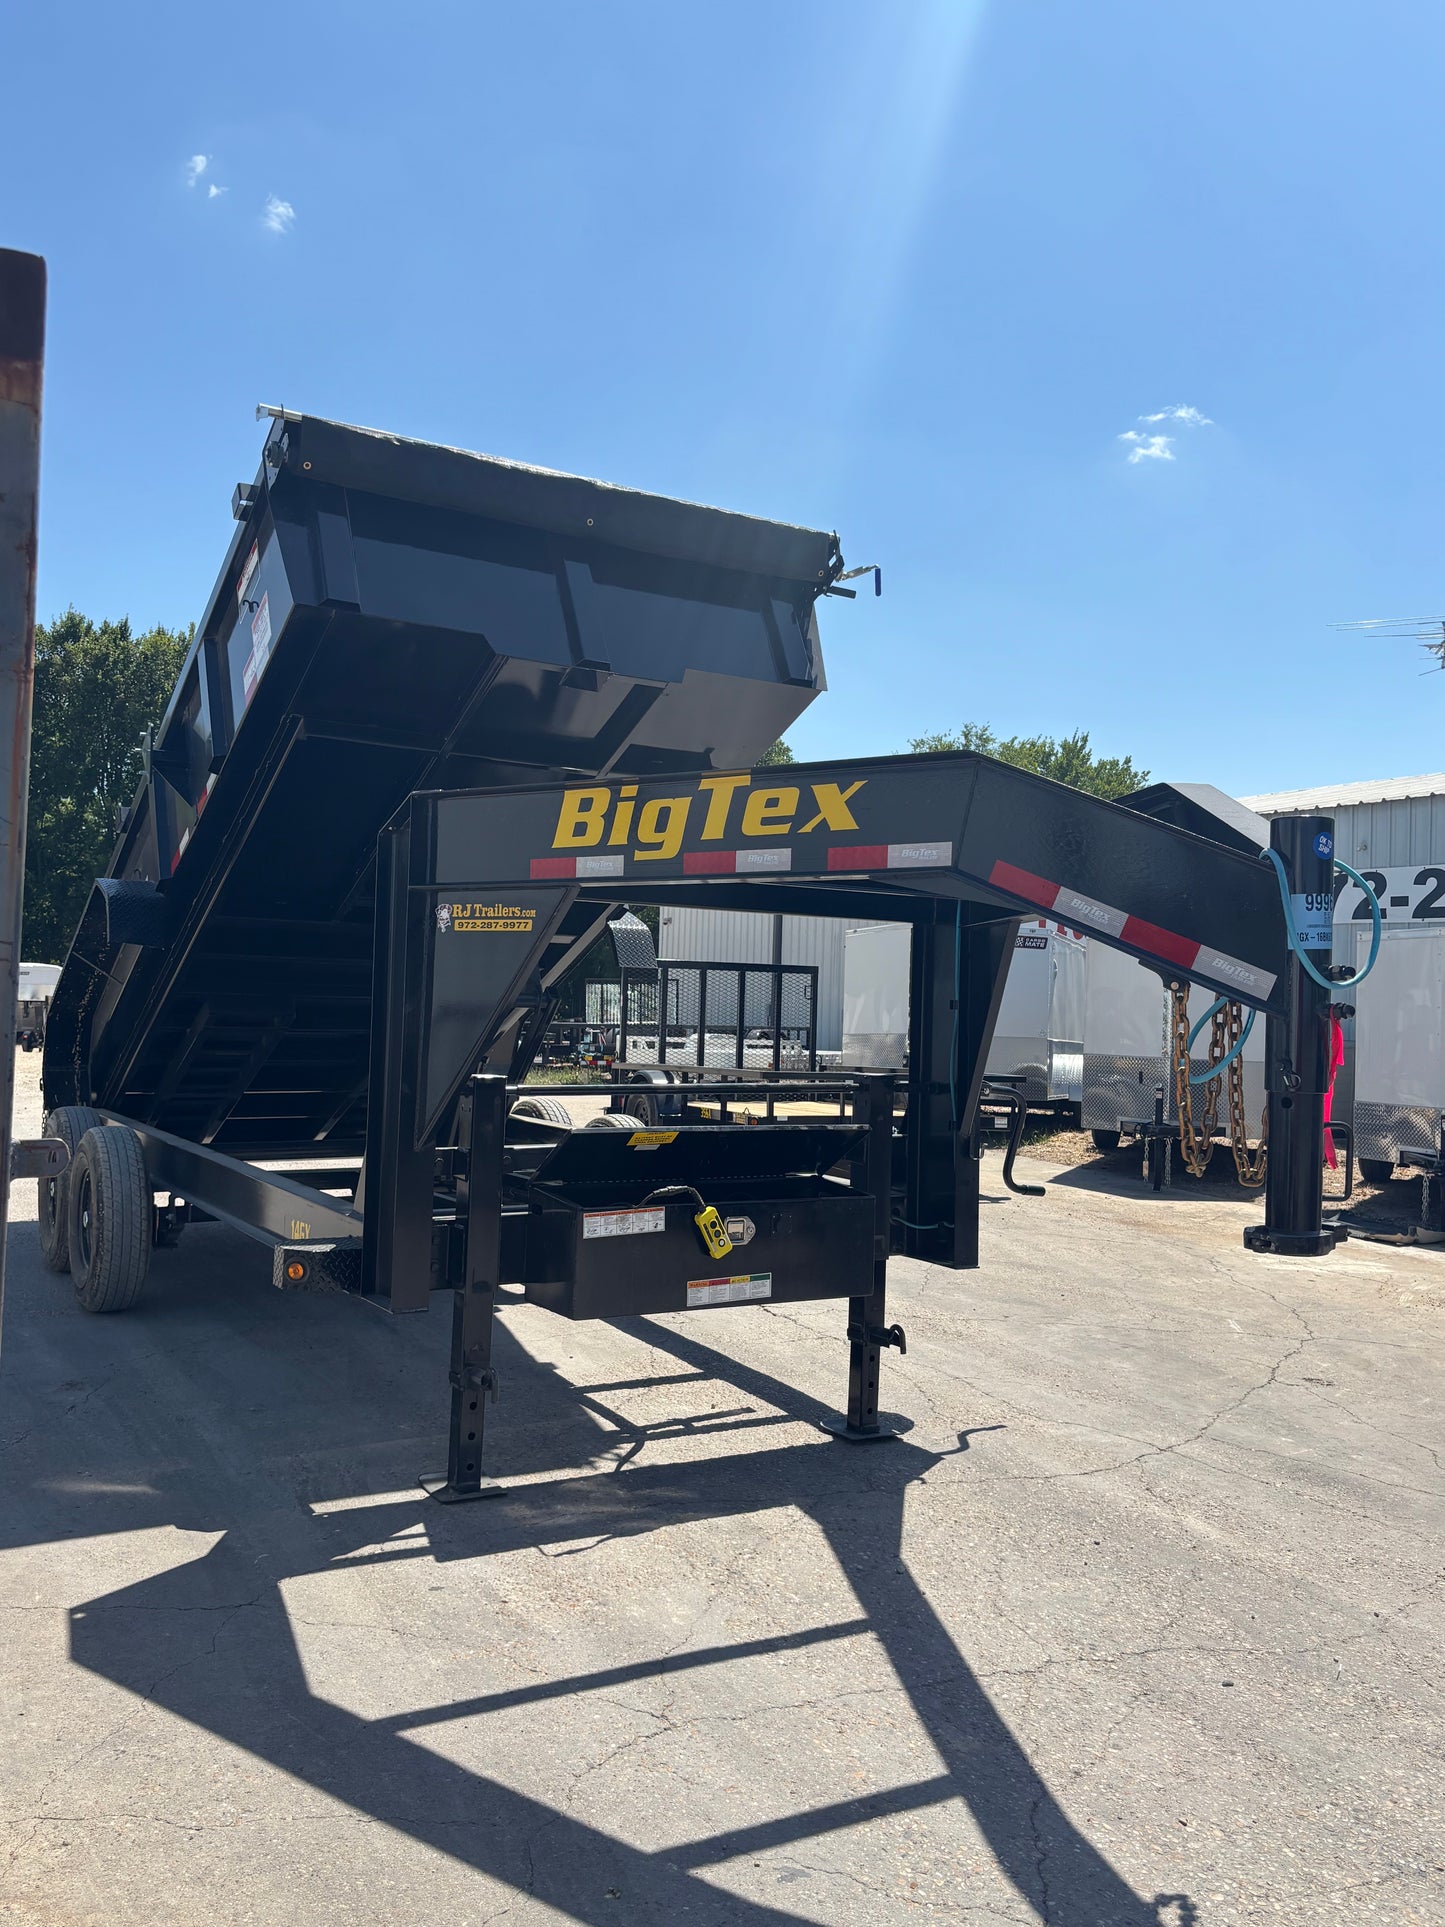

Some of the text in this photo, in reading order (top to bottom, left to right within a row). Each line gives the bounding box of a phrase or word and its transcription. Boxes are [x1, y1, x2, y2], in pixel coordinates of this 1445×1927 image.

[551, 775, 868, 861] BigTex
[452, 904, 472, 917] RJ
[457, 921, 529, 929] 972-287-9977
[1212, 958, 1257, 984] BigTex
